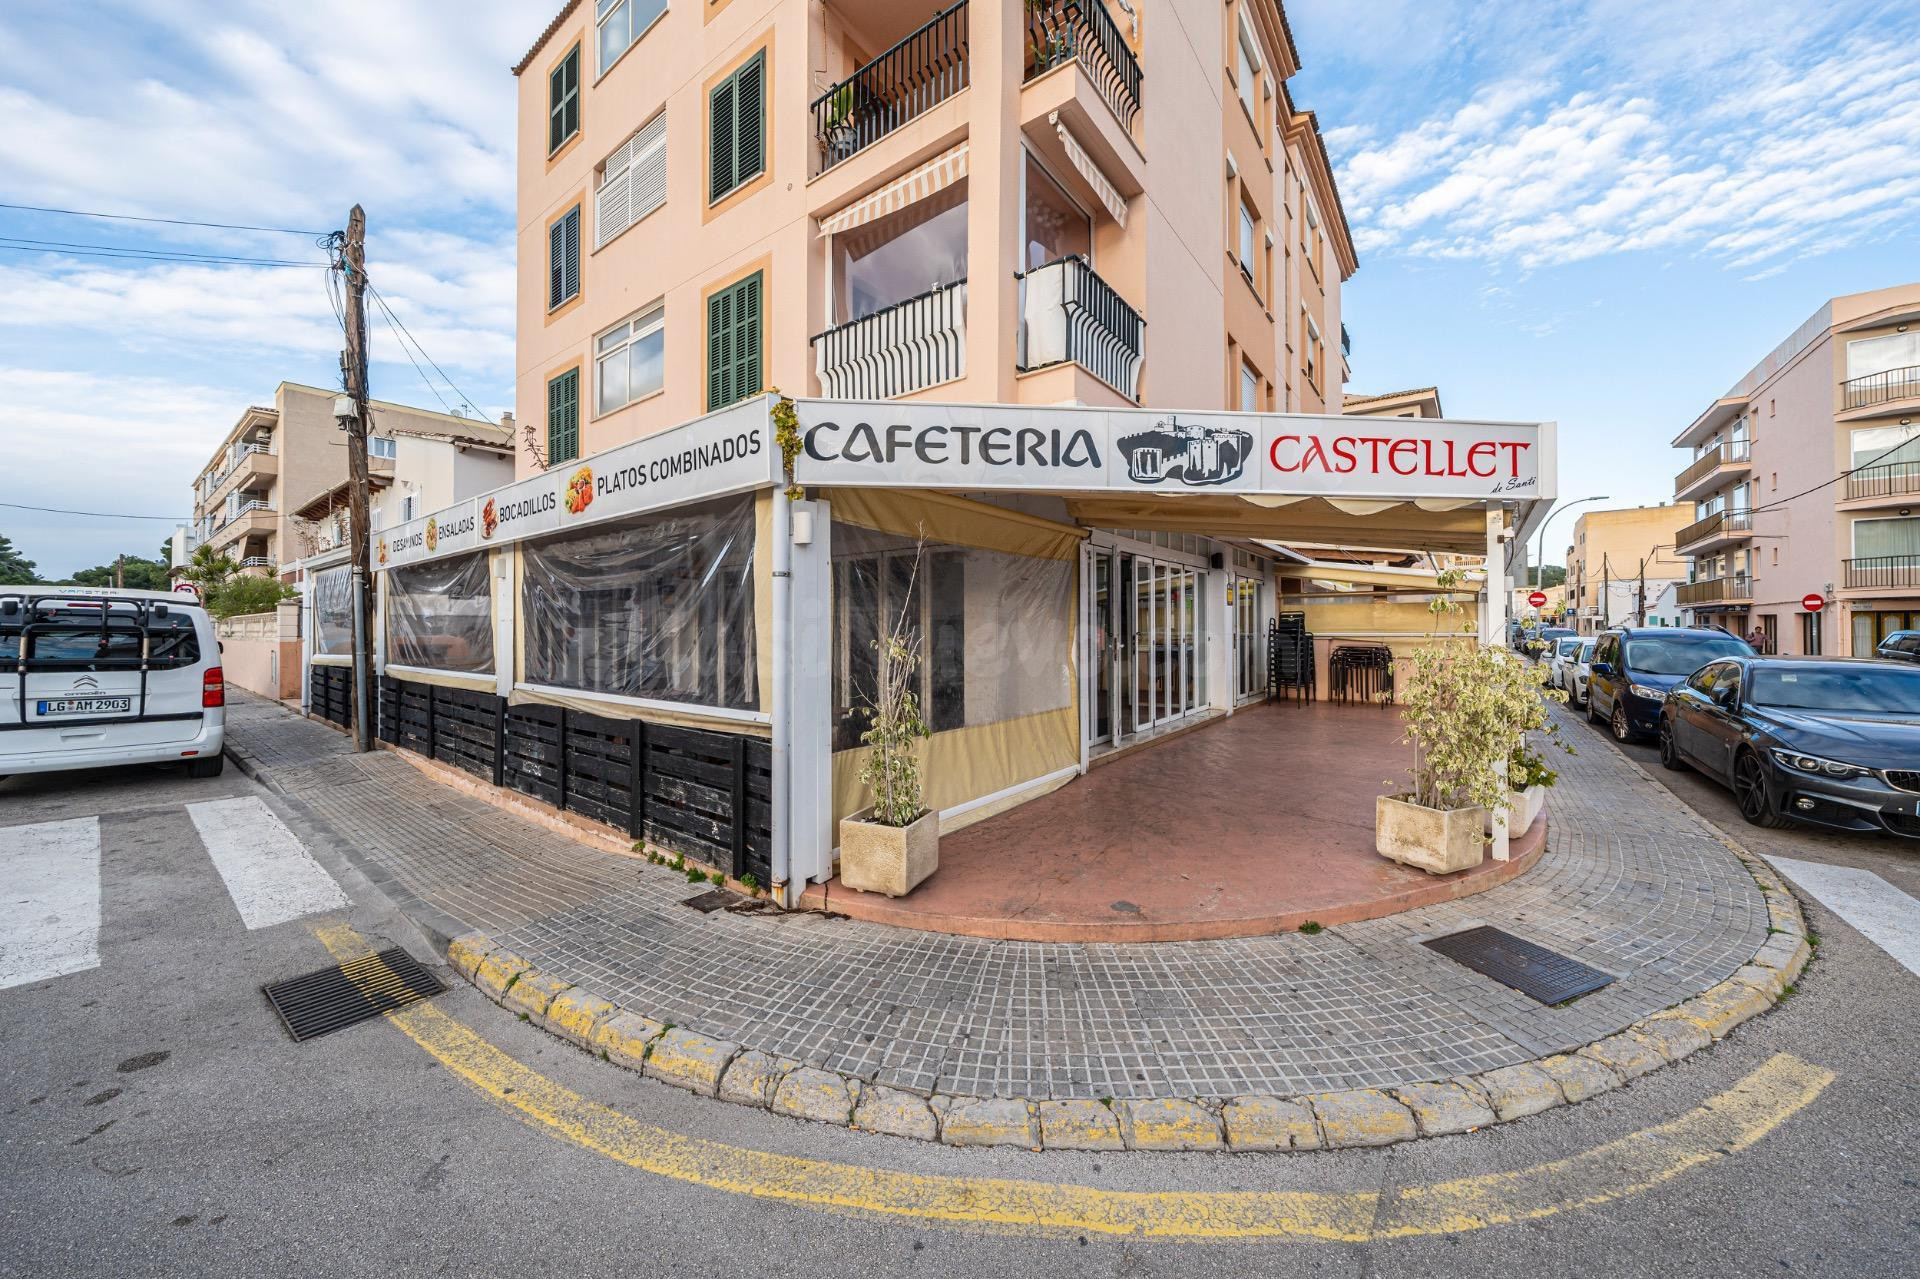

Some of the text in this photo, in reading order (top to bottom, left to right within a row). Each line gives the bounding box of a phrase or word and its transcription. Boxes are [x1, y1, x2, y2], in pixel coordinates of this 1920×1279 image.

[803, 422, 1102, 468] CAFETERIA
[1269, 435, 1531, 478] CASTELLET
[597, 429, 761, 496] PLATOS COMBINADOS
[1490, 476, 1537, 494] de Santi
[499, 492, 556, 523] BOCADILLOS
[438, 516, 475, 540] ENSALADAS
[47, 701, 66, 712] LG
[75, 700, 93, 711] AM
[95, 699, 128, 710] 2903
